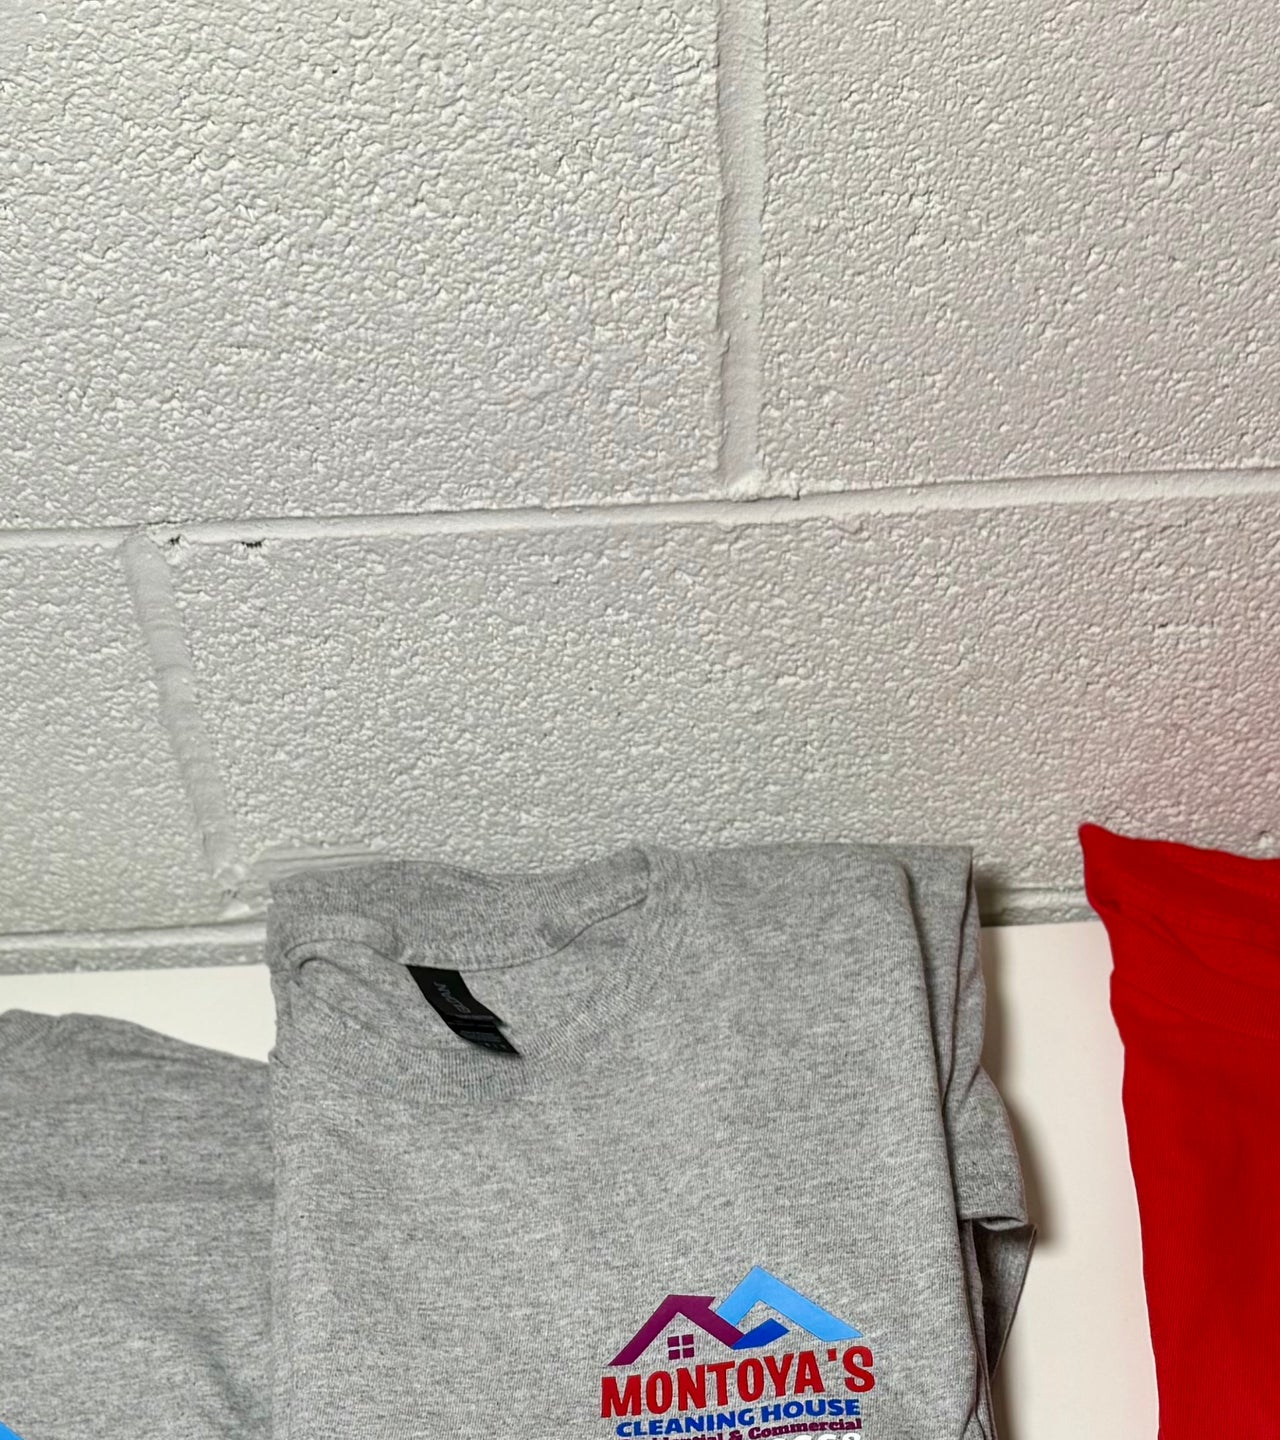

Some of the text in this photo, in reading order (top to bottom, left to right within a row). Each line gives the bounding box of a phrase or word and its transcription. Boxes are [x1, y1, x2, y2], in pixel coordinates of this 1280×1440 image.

[600, 1345, 876, 1418] MONTOYA'S
[616, 1399, 861, 1437] CLEANING HOUSE
[748, 1418, 862, 1440] Commercial
